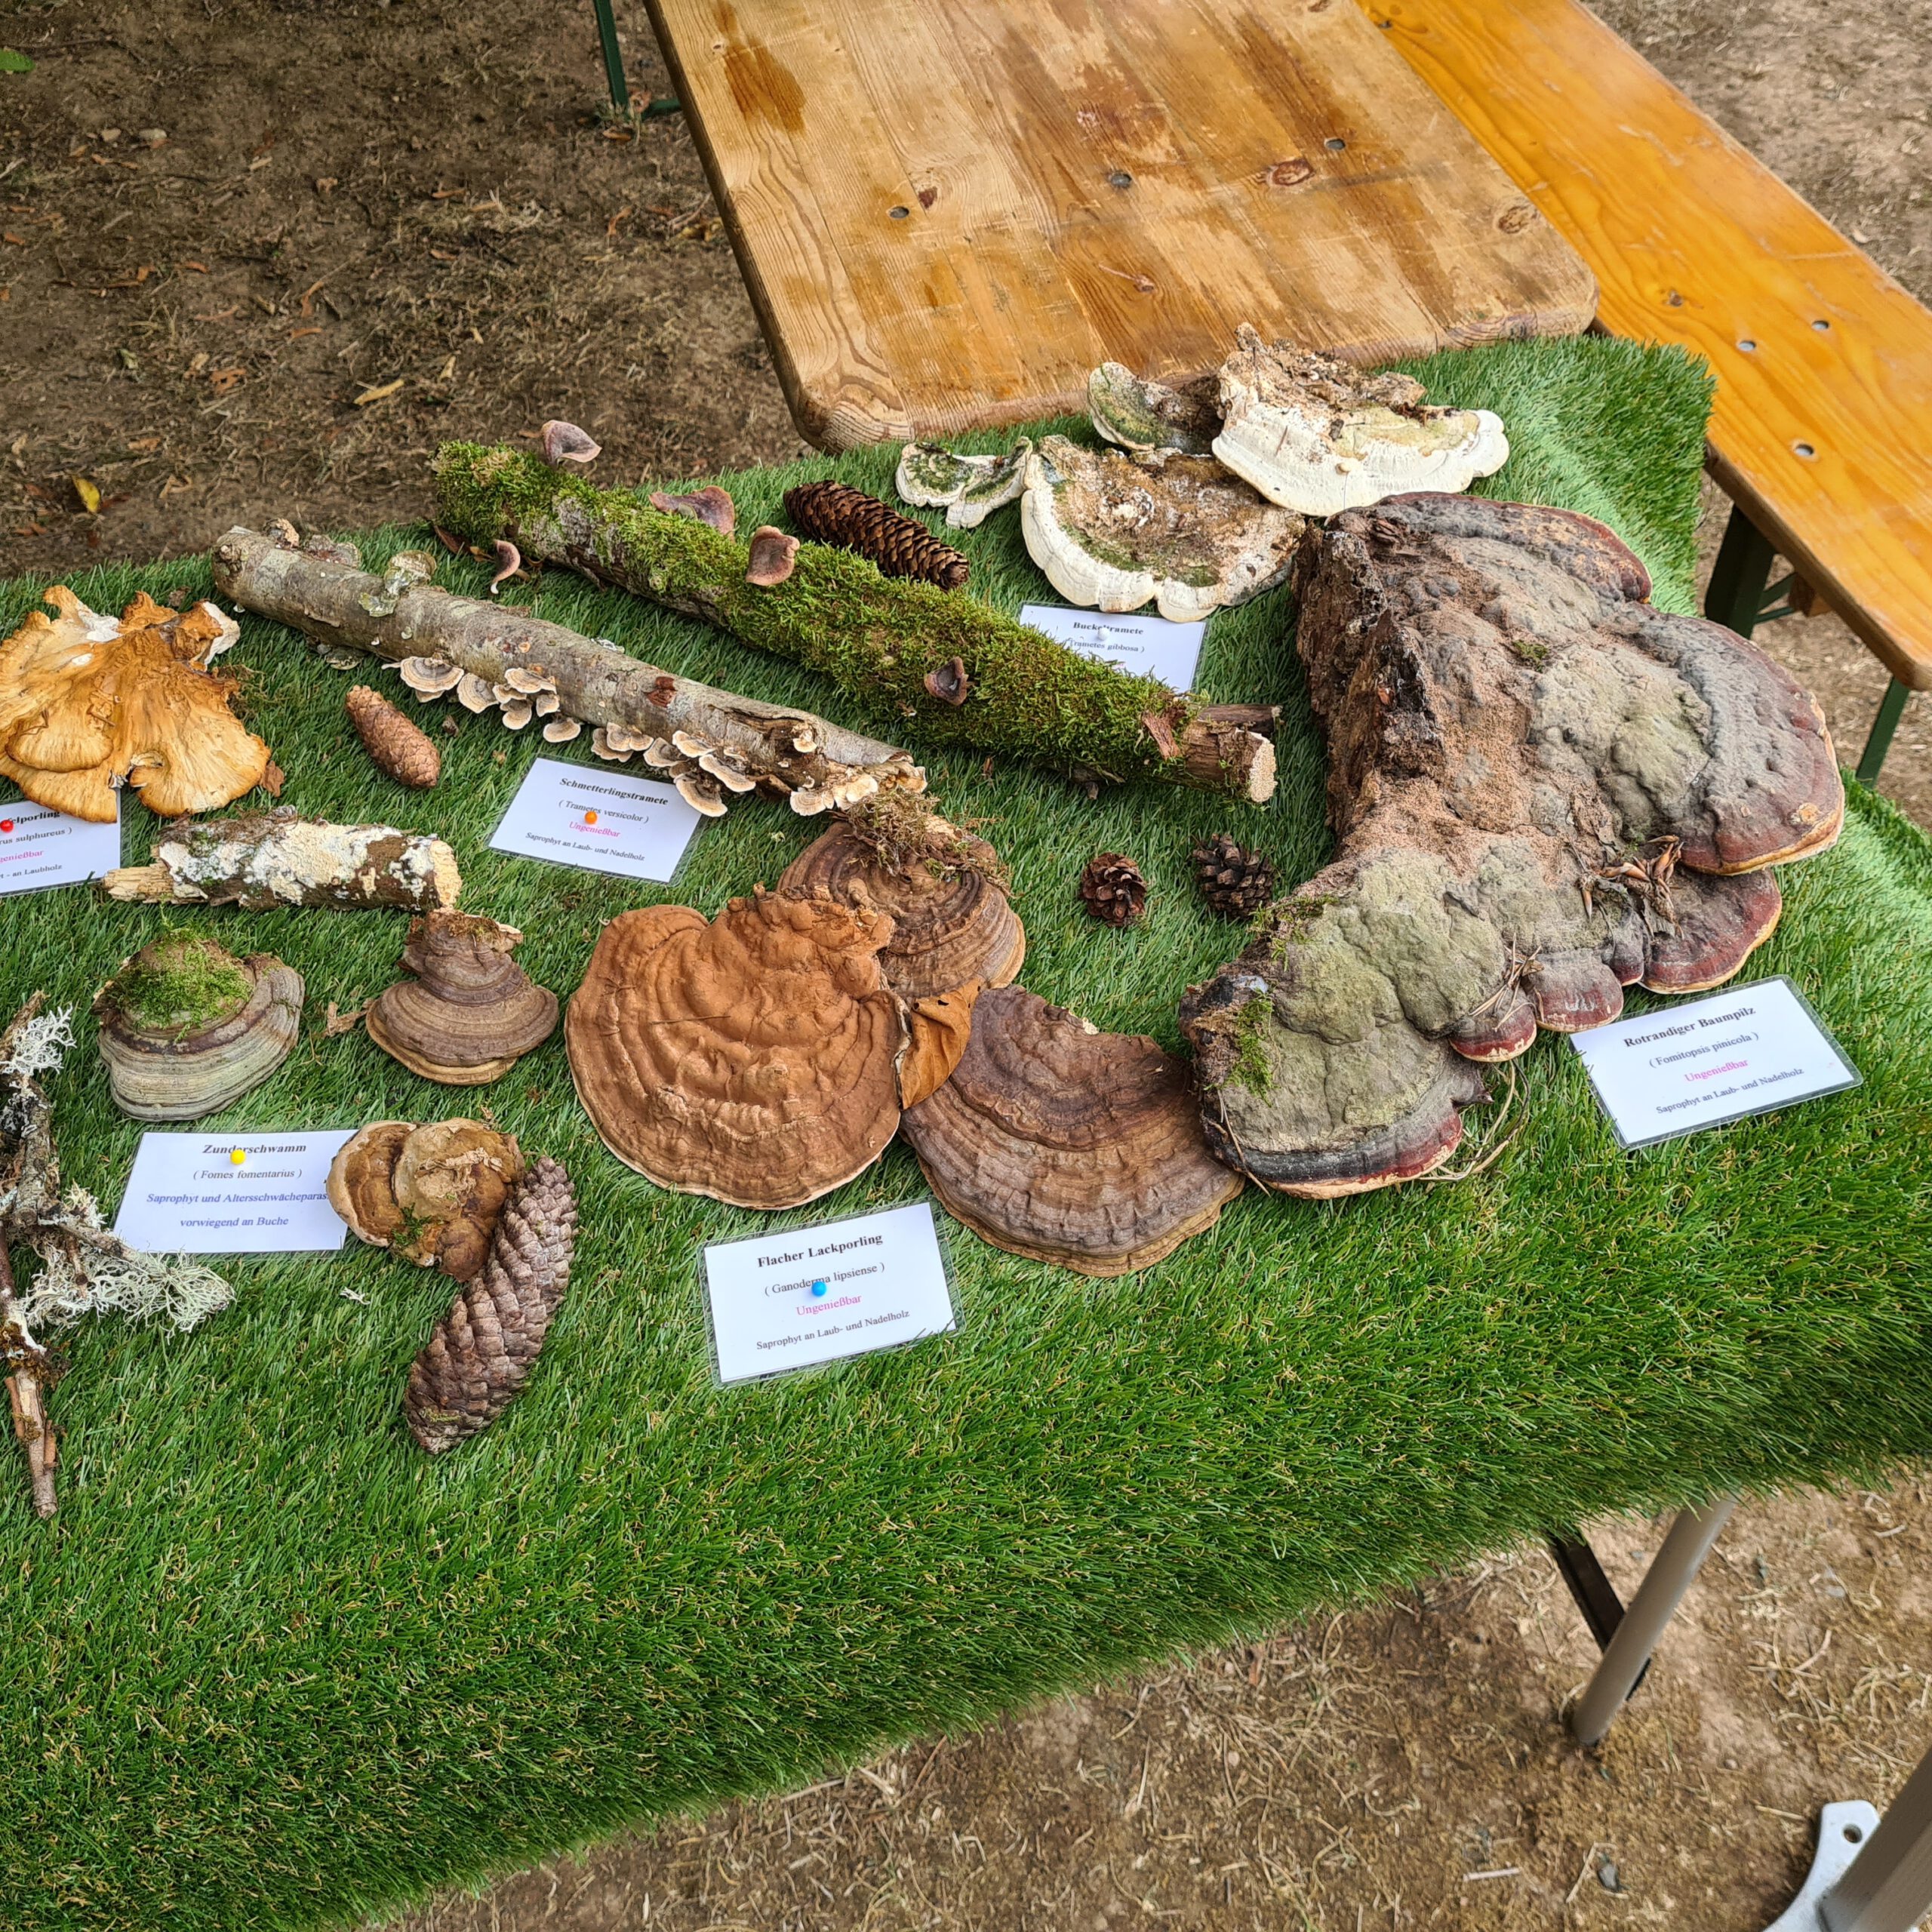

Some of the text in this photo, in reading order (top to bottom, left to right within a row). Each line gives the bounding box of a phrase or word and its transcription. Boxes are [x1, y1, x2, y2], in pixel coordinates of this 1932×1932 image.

[1107, 643, 1139, 652] gibbosa
[559, 778, 669, 805] Schmetterlingstramete
[566, 801, 601, 814] Trametes
[604, 809, 644, 822] versicolor
[16, 829, 65, 841] sulphureus
[569, 821, 620, 838] Ungenießbar
[525, 832, 561, 845] Saprophyt
[572, 842, 592, 851] Laub-
[595, 846, 608, 854] und
[610, 849, 645, 861] Nadelholz
[24, 864, 63, 875] Laubholz
[1623, 1007, 1756, 1047] Rotrandiger Baumpilz
[1655, 1045, 1711, 1066] Fomitopsis
[1712, 1034, 1752, 1052] pinicola
[1684, 1059, 1749, 1081] Ungenießbar
[1656, 1097, 1701, 1114] Saprophyt
[1713, 1087, 1740, 1098] Laub-
[1741, 1080, 1758, 1091] und
[1759, 1068, 1804, 1085] Nadelholz
[202, 1144, 306, 1154] Zundrschwamm
[201, 1171, 233, 1179] Fomes
[237, 1169, 295, 1179] fomentarius
[146, 1192, 329, 1204] Saprophyt und Altersschwächeparas
[180, 1217, 238, 1229] vorwiegend
[256, 1217, 289, 1226] Buche
[758, 1235, 884, 1268] Flacher Lackporling
[833, 1264, 878, 1281] lipsiense
[796, 1295, 862, 1315] Ungenießbar
[756, 1310, 910, 1350] Saprophyt an Laub- und Nadelholz
